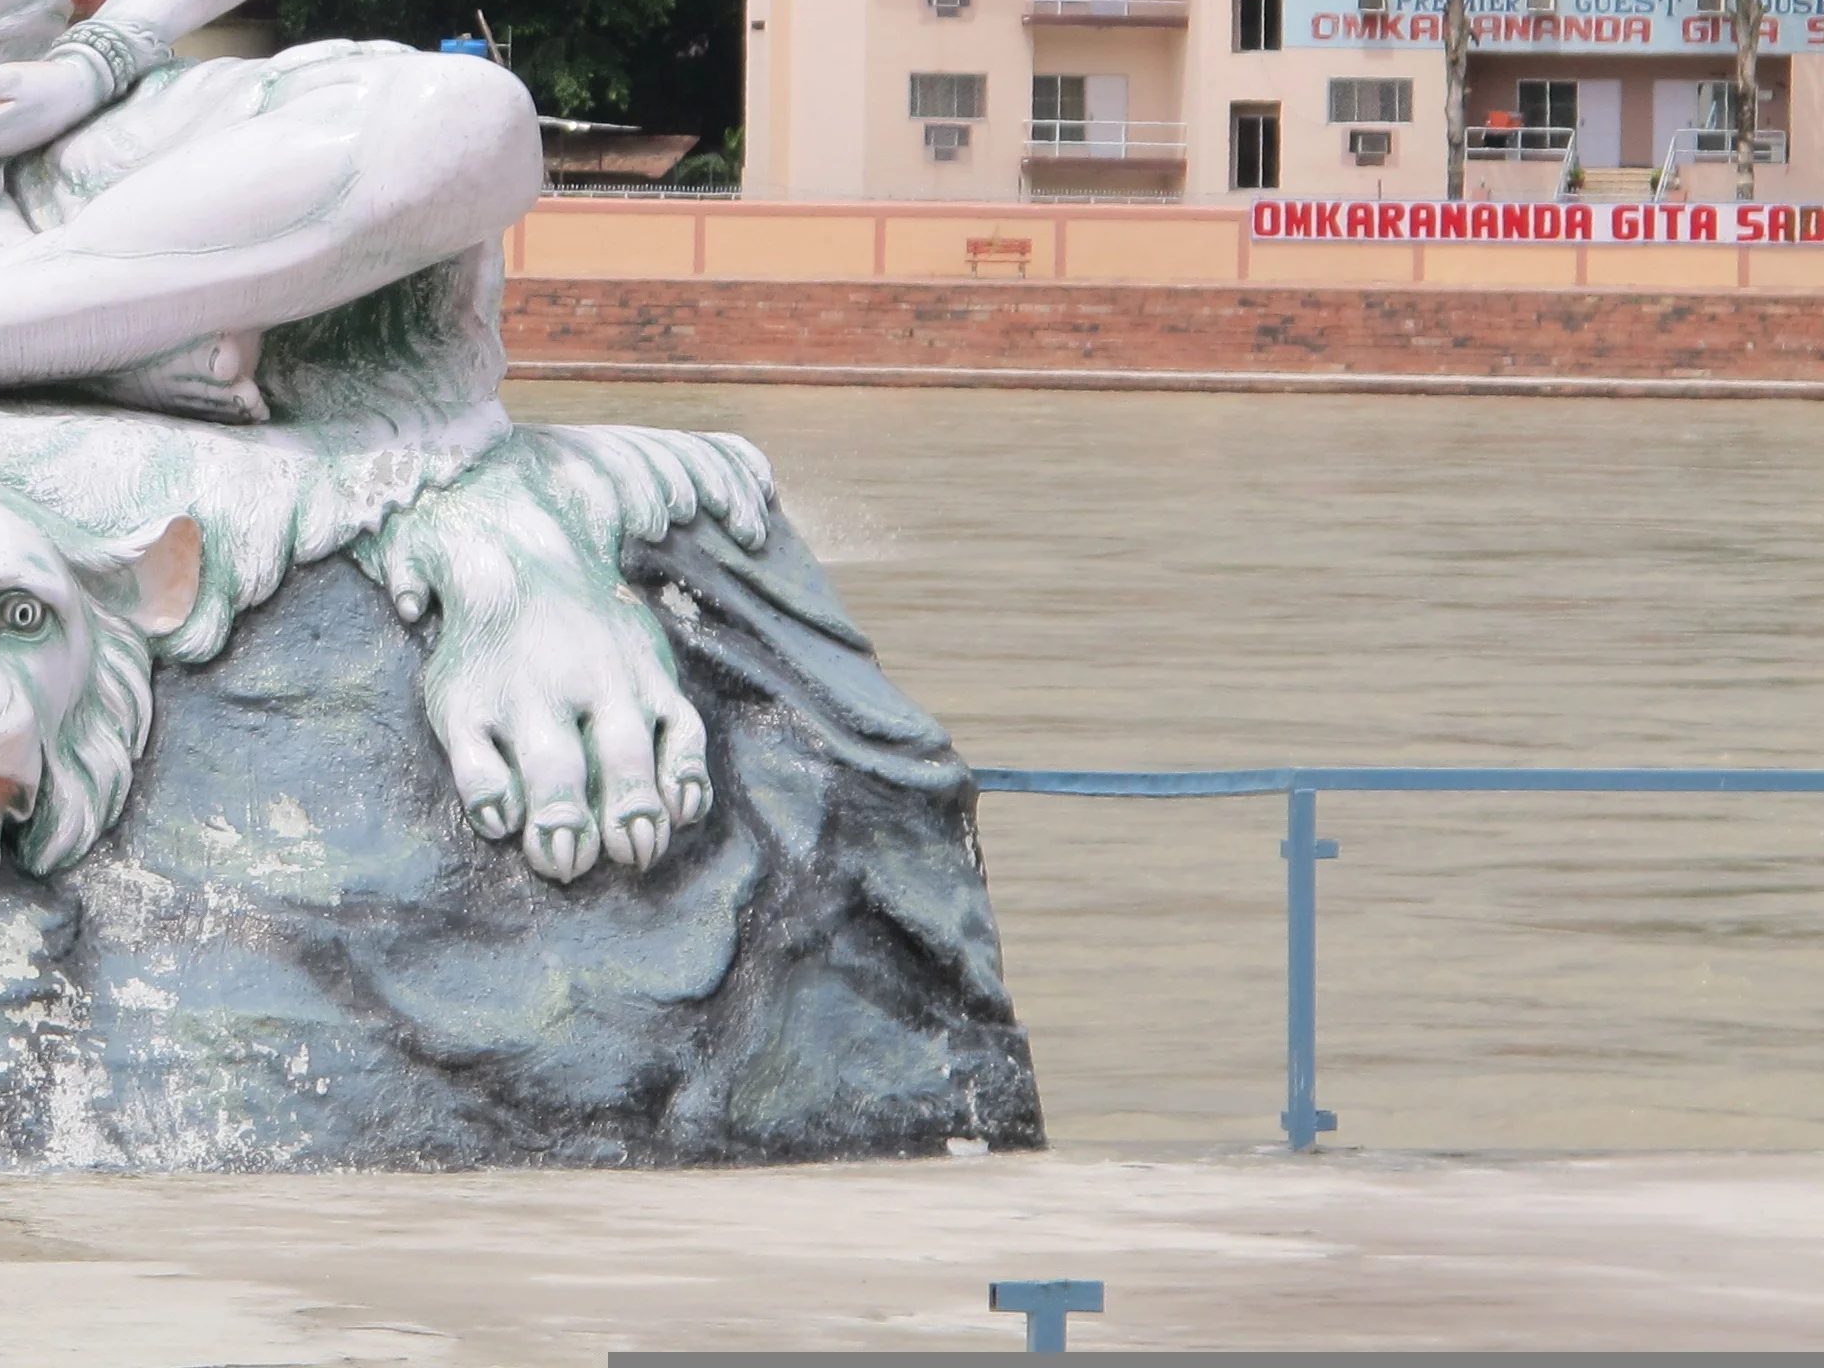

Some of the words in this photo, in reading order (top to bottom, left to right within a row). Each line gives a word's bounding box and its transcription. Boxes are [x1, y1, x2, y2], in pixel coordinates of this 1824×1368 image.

[1311, 13, 1652, 43] OMKAANANDA
[1254, 201, 1593, 240] OMKARANANDA
[1612, 204, 1718, 241] GITA
